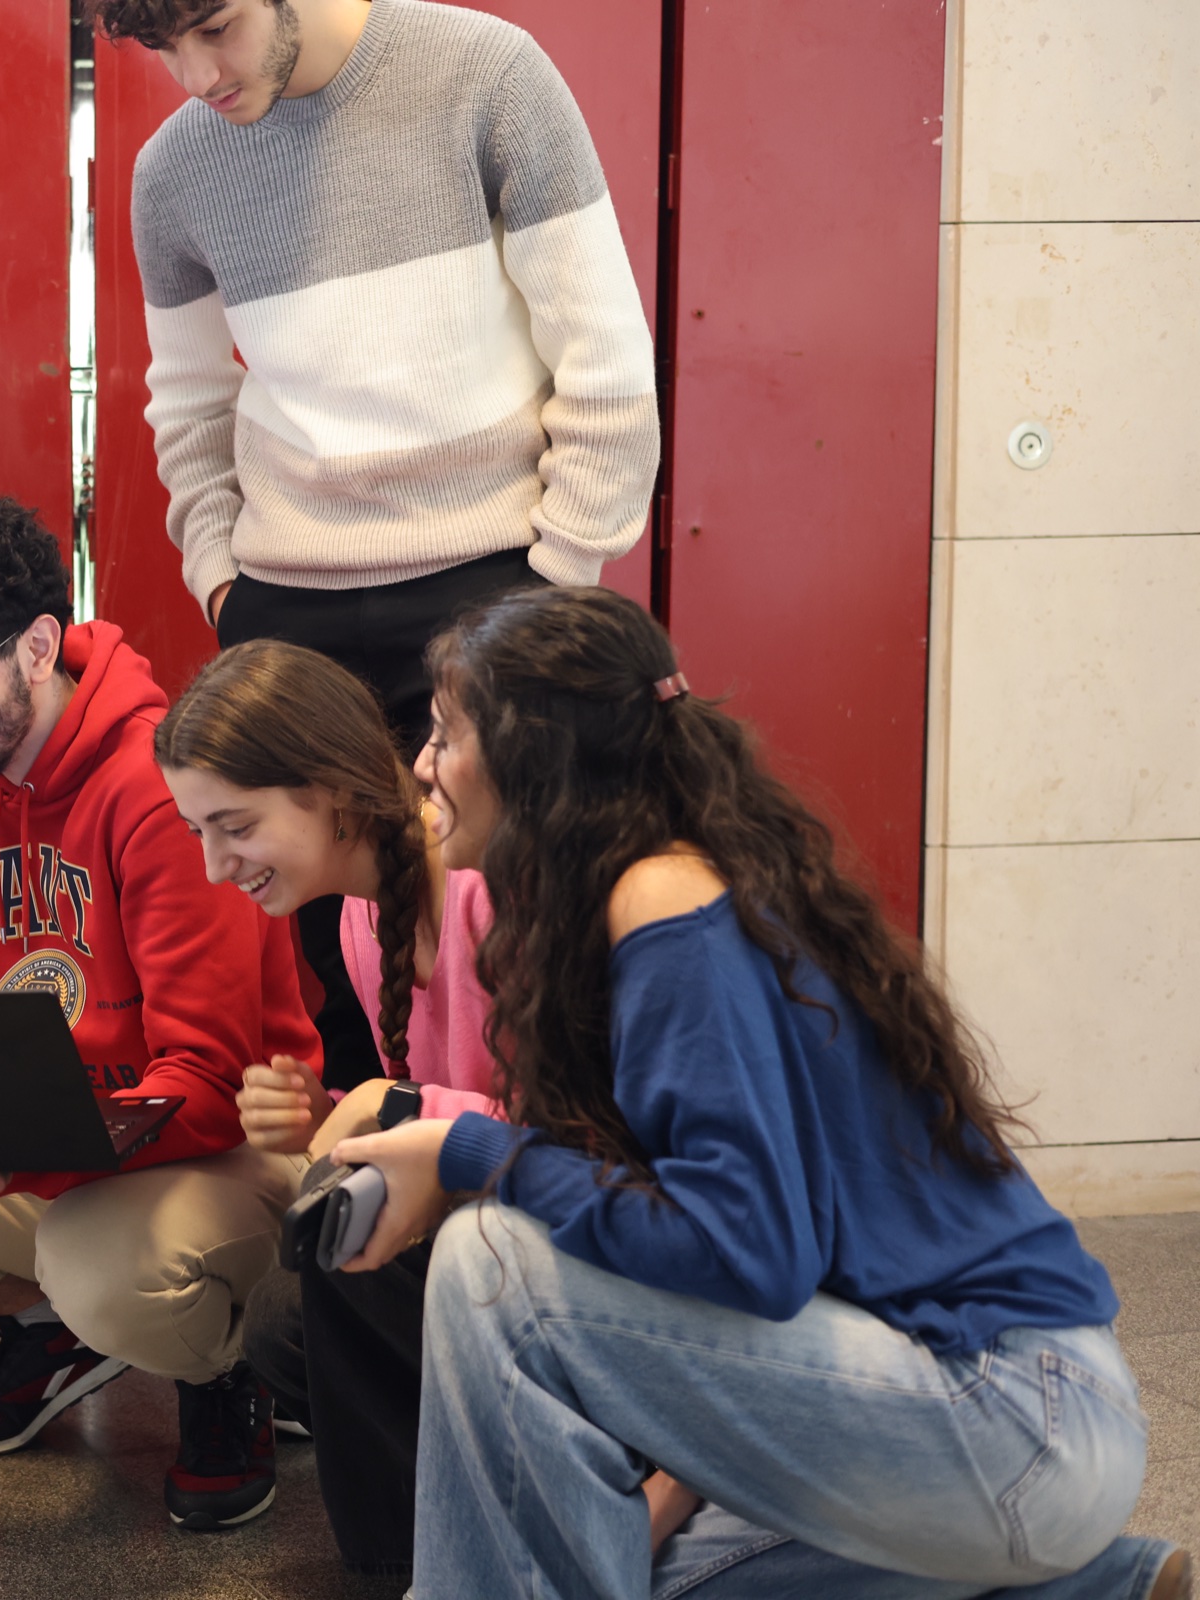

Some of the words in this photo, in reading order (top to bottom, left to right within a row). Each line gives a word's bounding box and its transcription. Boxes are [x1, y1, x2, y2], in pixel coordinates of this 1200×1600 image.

[19, 964, 33, 977] SPIRIT
[41, 960, 61, 968] AMERICAN
[61, 965, 75, 992] SPORTSWEAR
